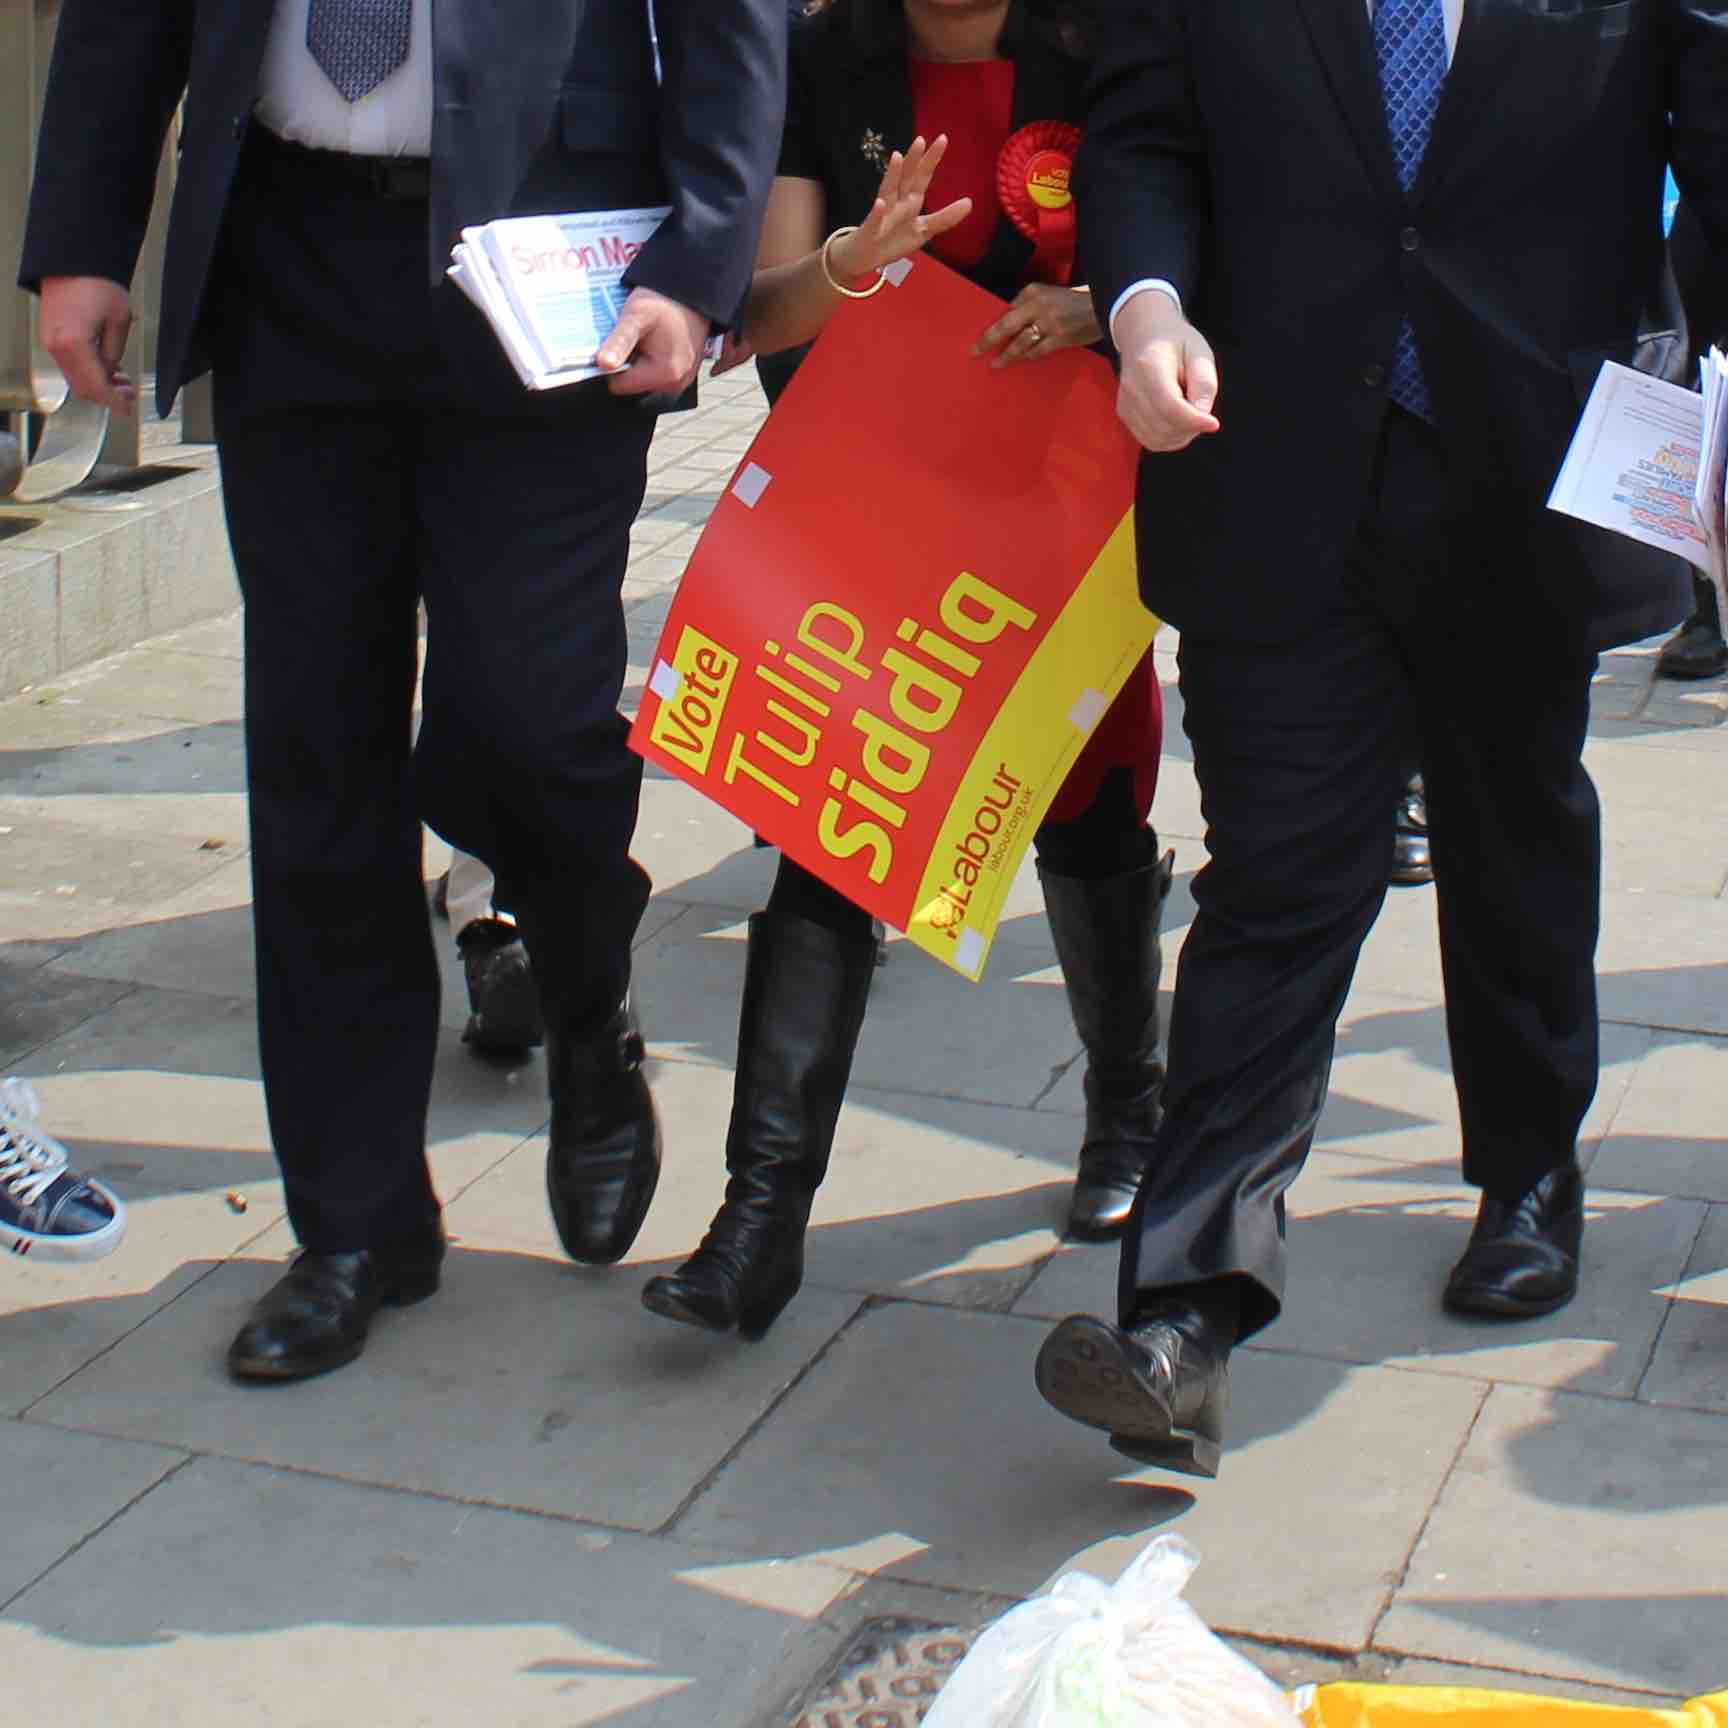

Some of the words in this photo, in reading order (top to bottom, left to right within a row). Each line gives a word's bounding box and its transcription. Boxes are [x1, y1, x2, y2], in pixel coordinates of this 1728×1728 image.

[511, 245, 601, 276] Simon
[598, 235, 642, 268] Ma
[659, 645, 732, 756] Vote
[723, 600, 873, 809] Tulip
[817, 570, 1040, 886] Siddiq
[942, 762, 1022, 908] Labour
